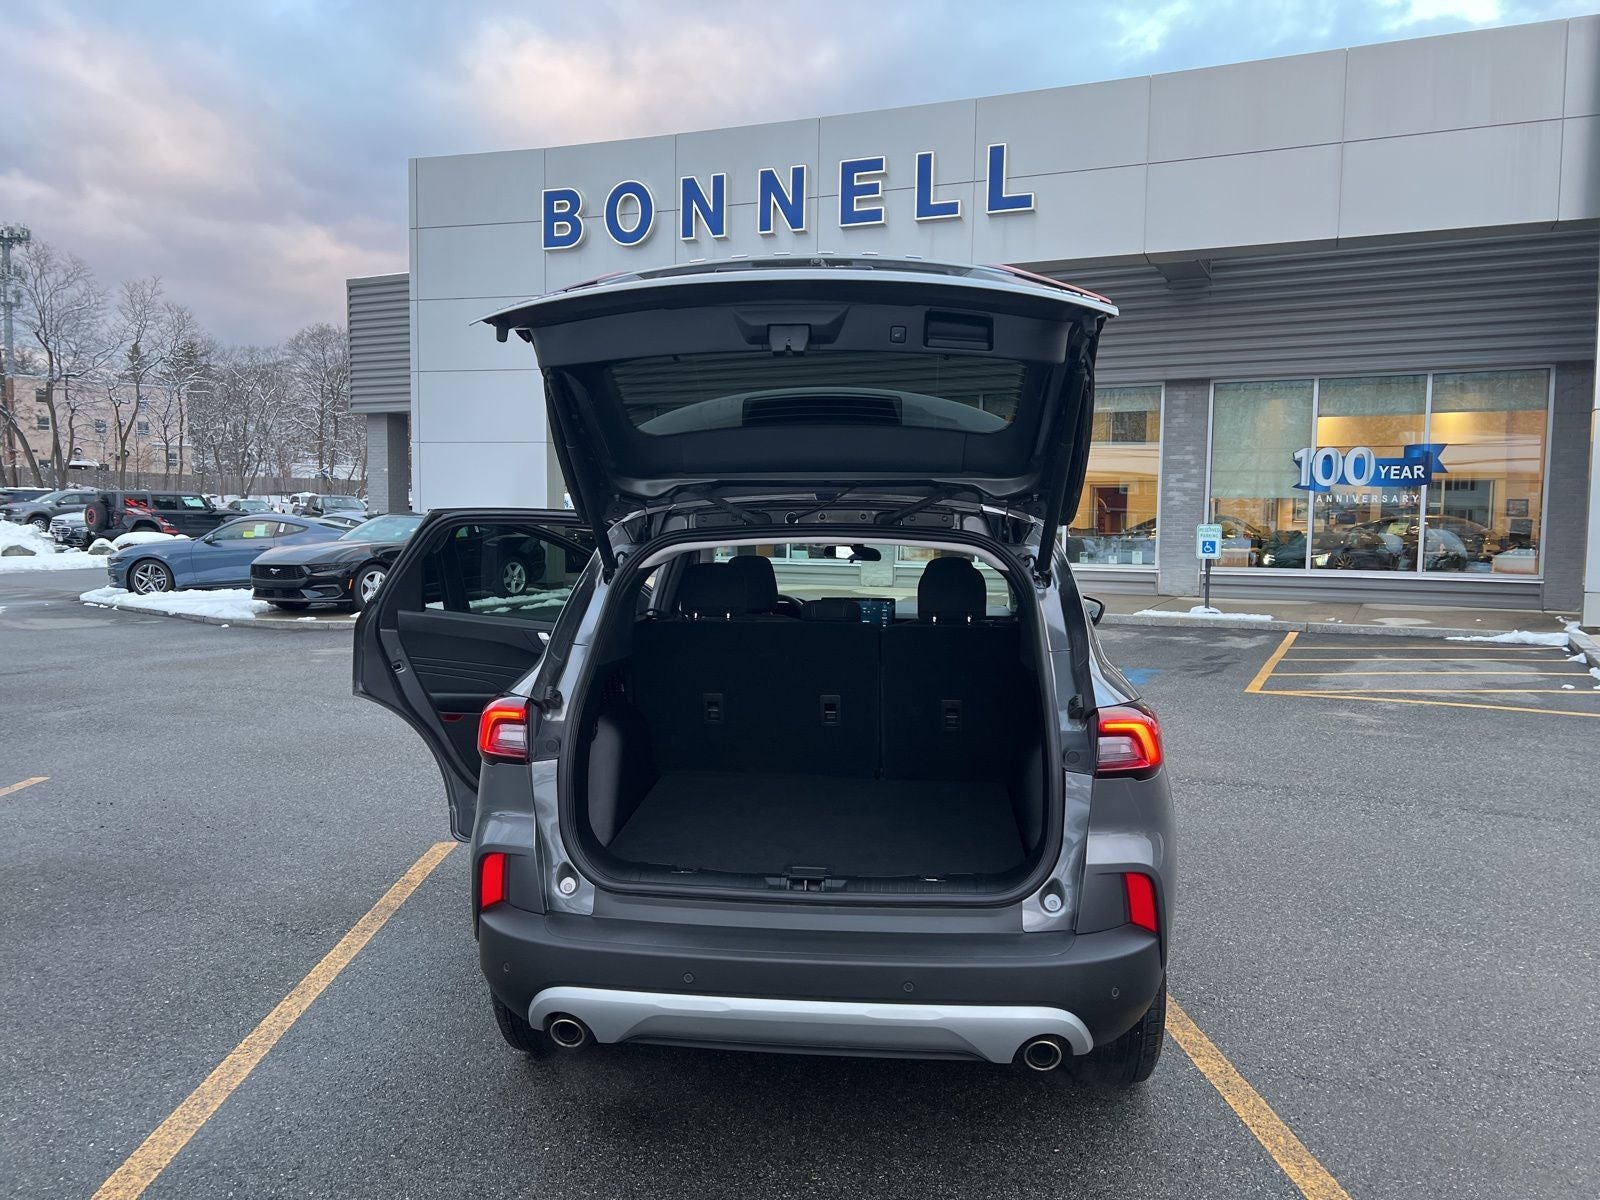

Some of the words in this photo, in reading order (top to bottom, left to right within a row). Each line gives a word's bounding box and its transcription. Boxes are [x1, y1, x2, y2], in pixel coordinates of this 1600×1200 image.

[541, 142, 1036, 251] BONNELL
[1294, 446, 1376, 487] 100
[1378, 465, 1425, 479] YEAR
[1316, 494, 1420, 503] ANNIVERSARY
